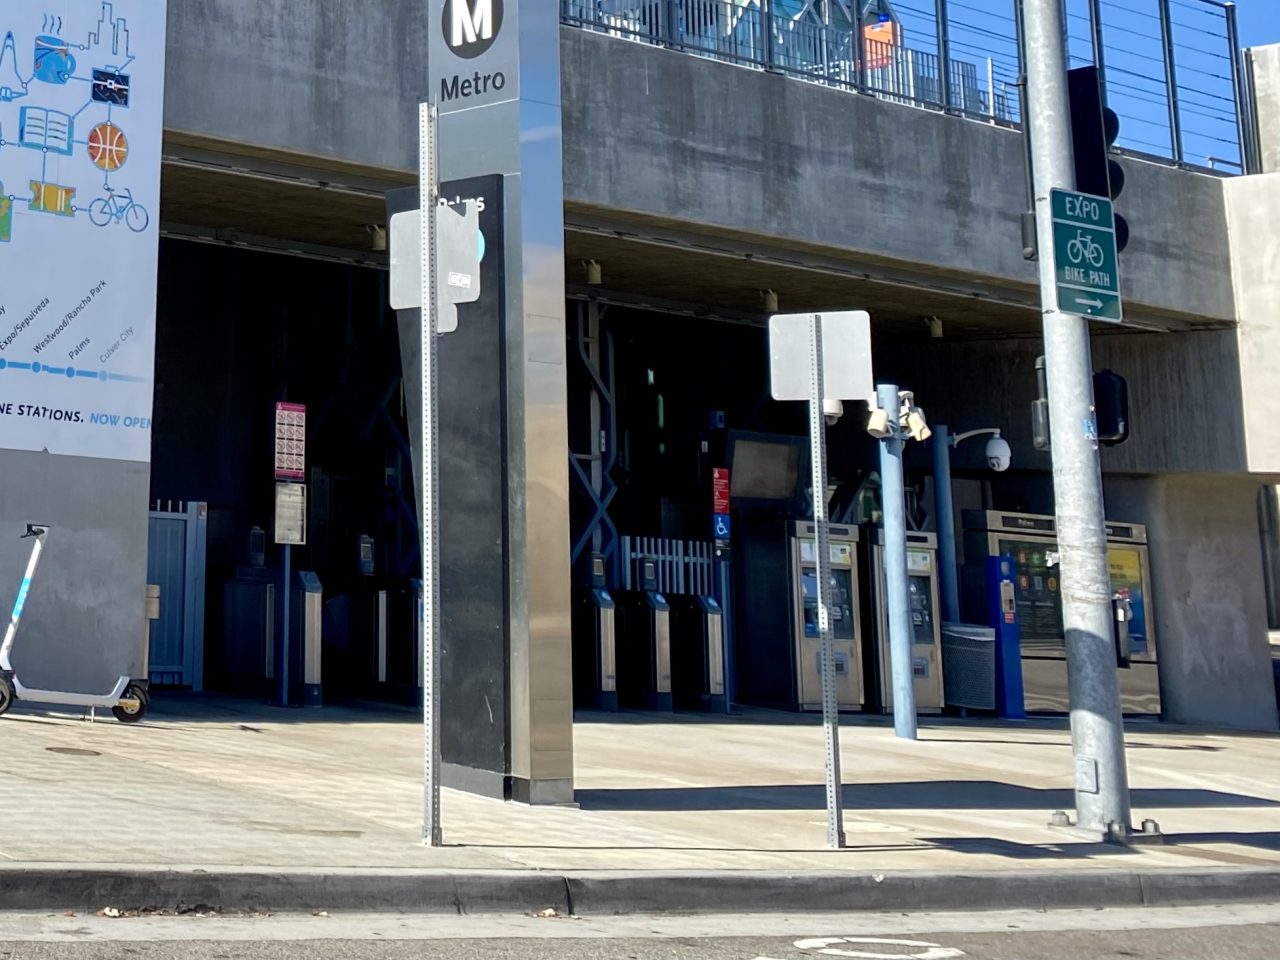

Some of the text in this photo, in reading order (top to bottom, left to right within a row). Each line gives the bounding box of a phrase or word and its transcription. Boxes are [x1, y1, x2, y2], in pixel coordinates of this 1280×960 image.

[441, 71, 505, 102] Metro
[1065, 197, 1099, 221] EXPO
[1064, 266, 1110, 287] BIKE PATH
[32, 279, 108, 355] Westwood/Rancho Park
[68, 336, 91, 361] Palms
[99, 325, 134, 364] Culver City
[17, 404, 84, 423] STATIONS.
[90, 412, 120, 427] NOW
